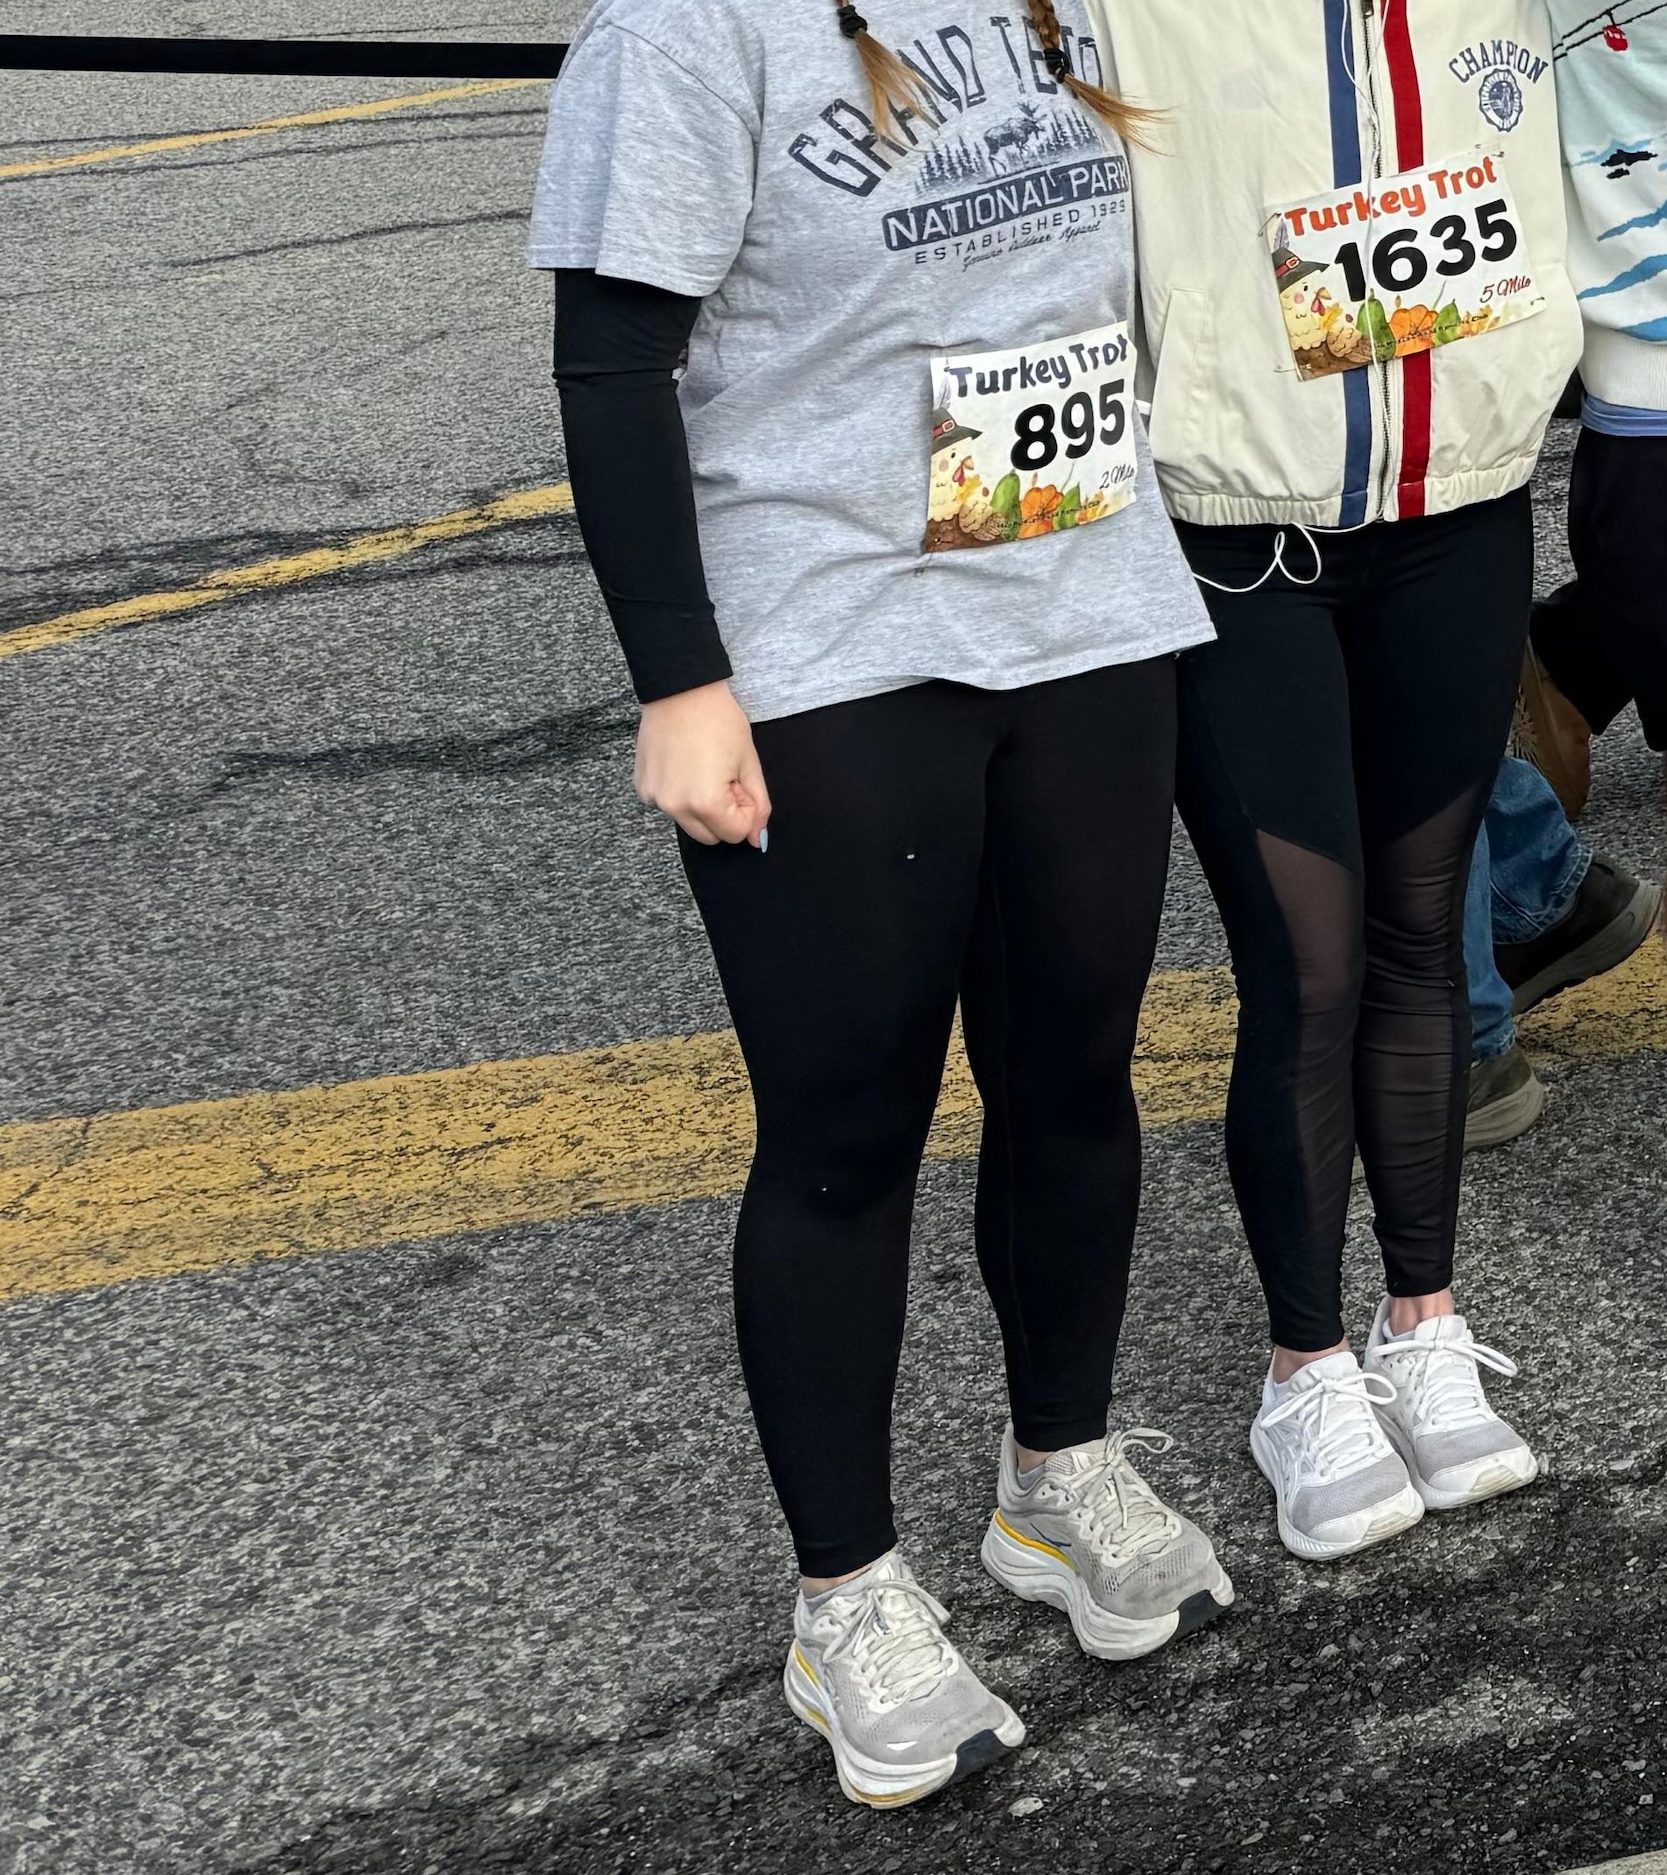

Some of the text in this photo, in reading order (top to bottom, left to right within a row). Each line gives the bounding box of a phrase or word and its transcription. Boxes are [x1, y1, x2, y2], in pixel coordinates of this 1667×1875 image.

[1449, 39, 1549, 84] CHAMPION
[788, 25, 987, 197] GRAND
[886, 160, 1130, 247] NATIONAL PARK
[1285, 156, 1497, 237] Turkey Trot
[914, 209, 1081, 265] ESTABLISHED
[1335, 198, 1517, 303] 1635
[1480, 276, 1532, 304] 5 Mile
[950, 335, 1128, 398] Turkey Trot
[1010, 379, 1126, 470] 895
[1100, 470, 1110, 490] 2
